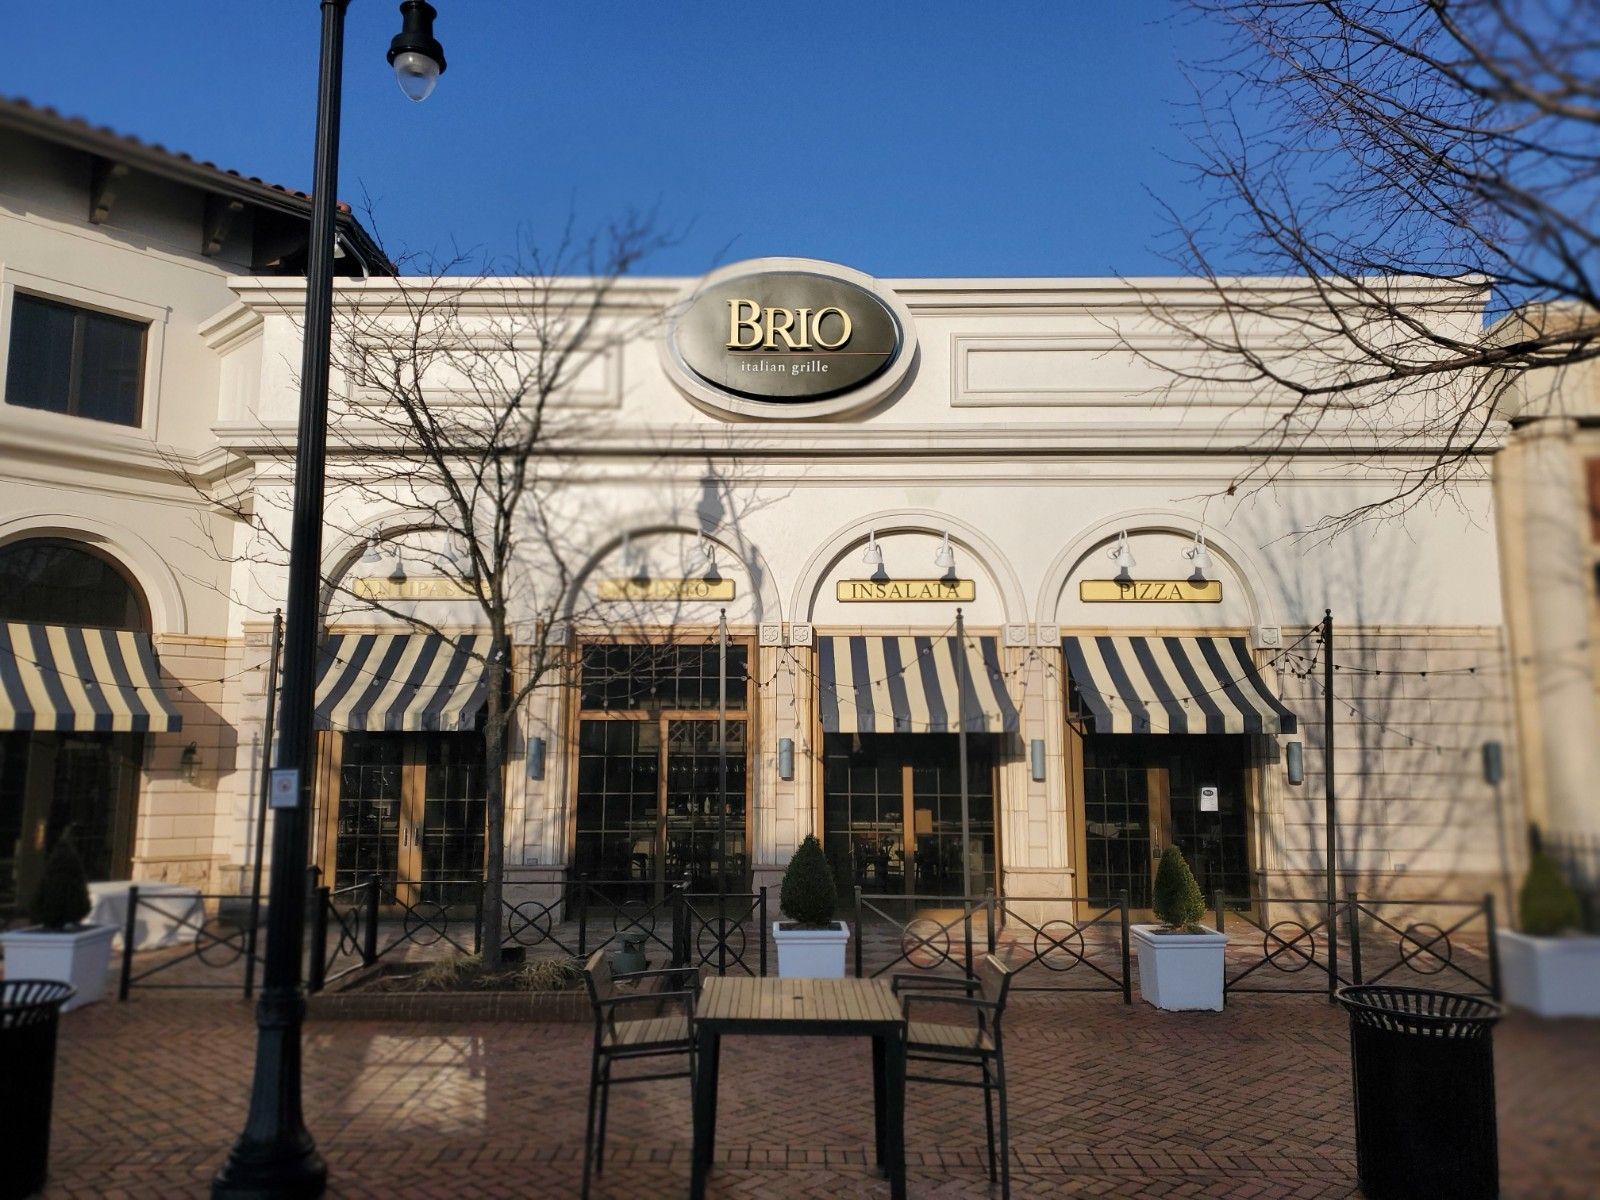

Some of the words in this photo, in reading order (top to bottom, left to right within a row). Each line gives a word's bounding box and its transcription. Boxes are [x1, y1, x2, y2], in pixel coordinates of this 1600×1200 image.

[726, 299, 852, 349] BRIO
[741, 360, 785, 372] italian
[791, 360, 829, 376] grille
[851, 583, 960, 599] INSALATA
[1120, 583, 1184, 600] PIZZA
